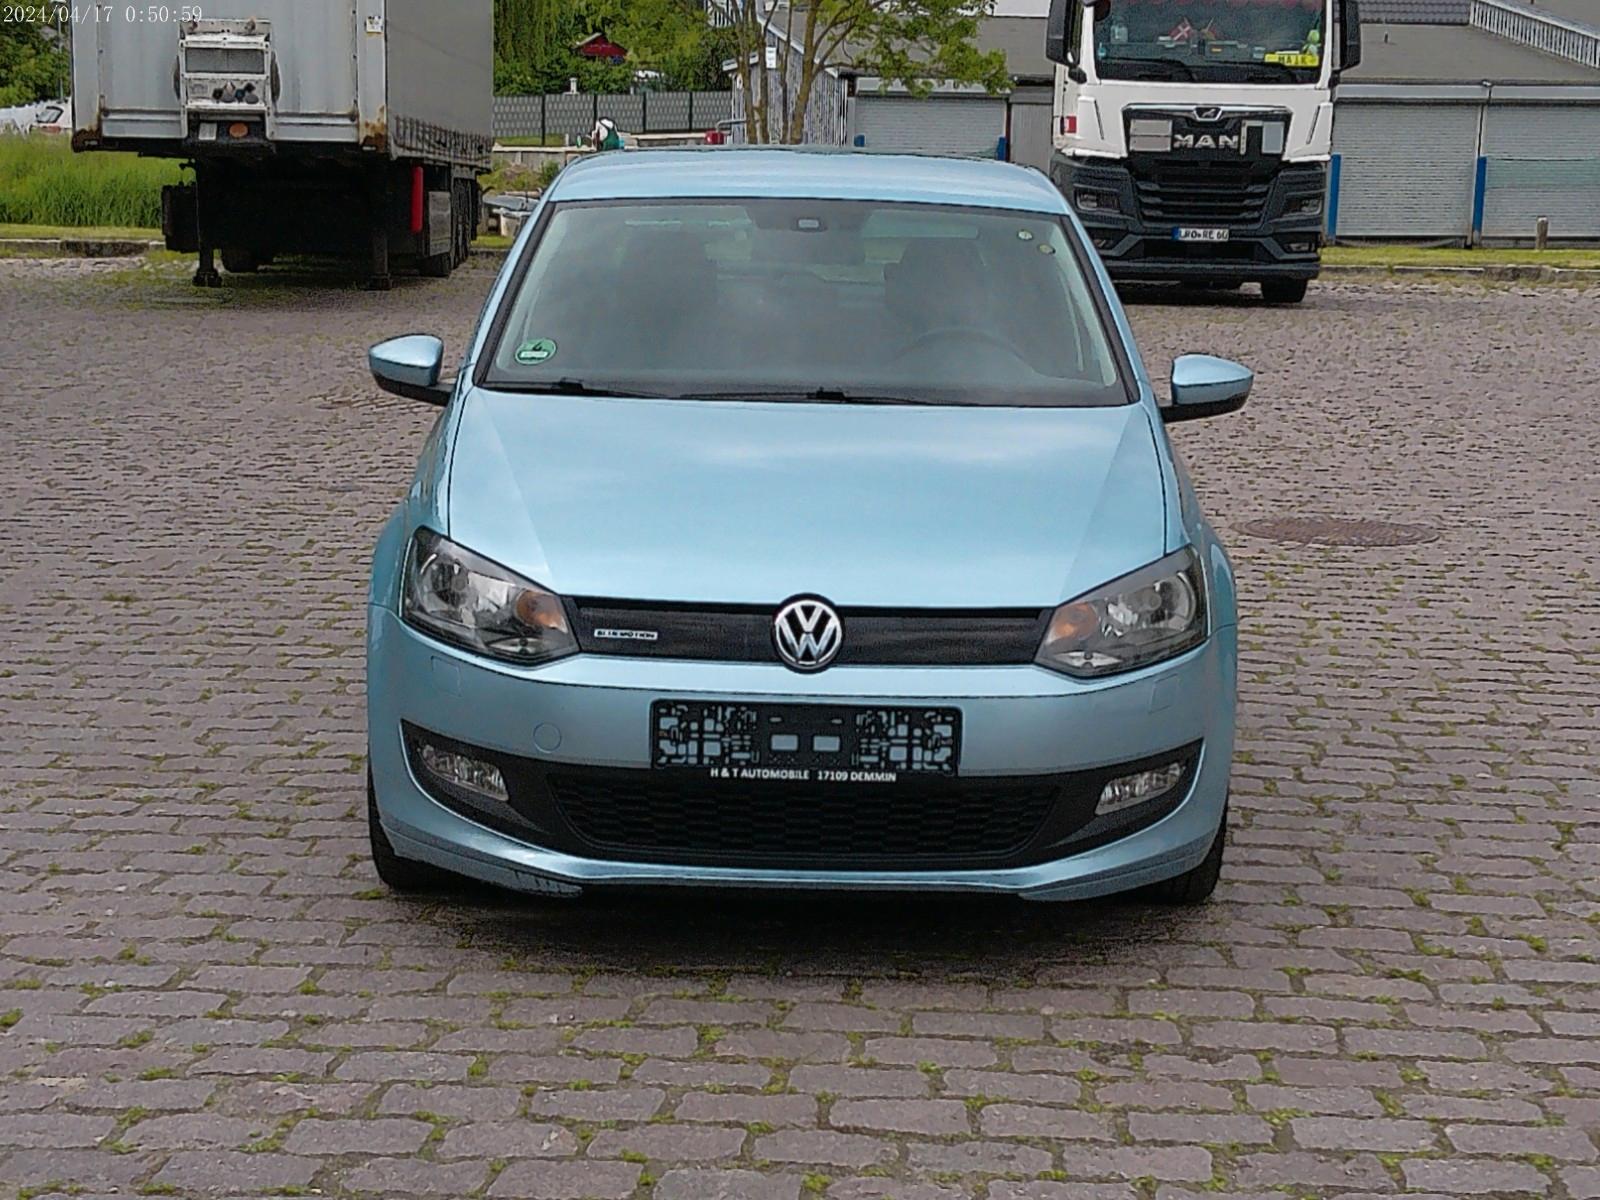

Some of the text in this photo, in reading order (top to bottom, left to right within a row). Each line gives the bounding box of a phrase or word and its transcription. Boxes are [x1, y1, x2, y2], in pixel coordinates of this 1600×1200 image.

[1173, 134, 1239, 149] MAN
[710, 768, 897, 783] H & T AUTOMOBILE 17109 DEMMIN
